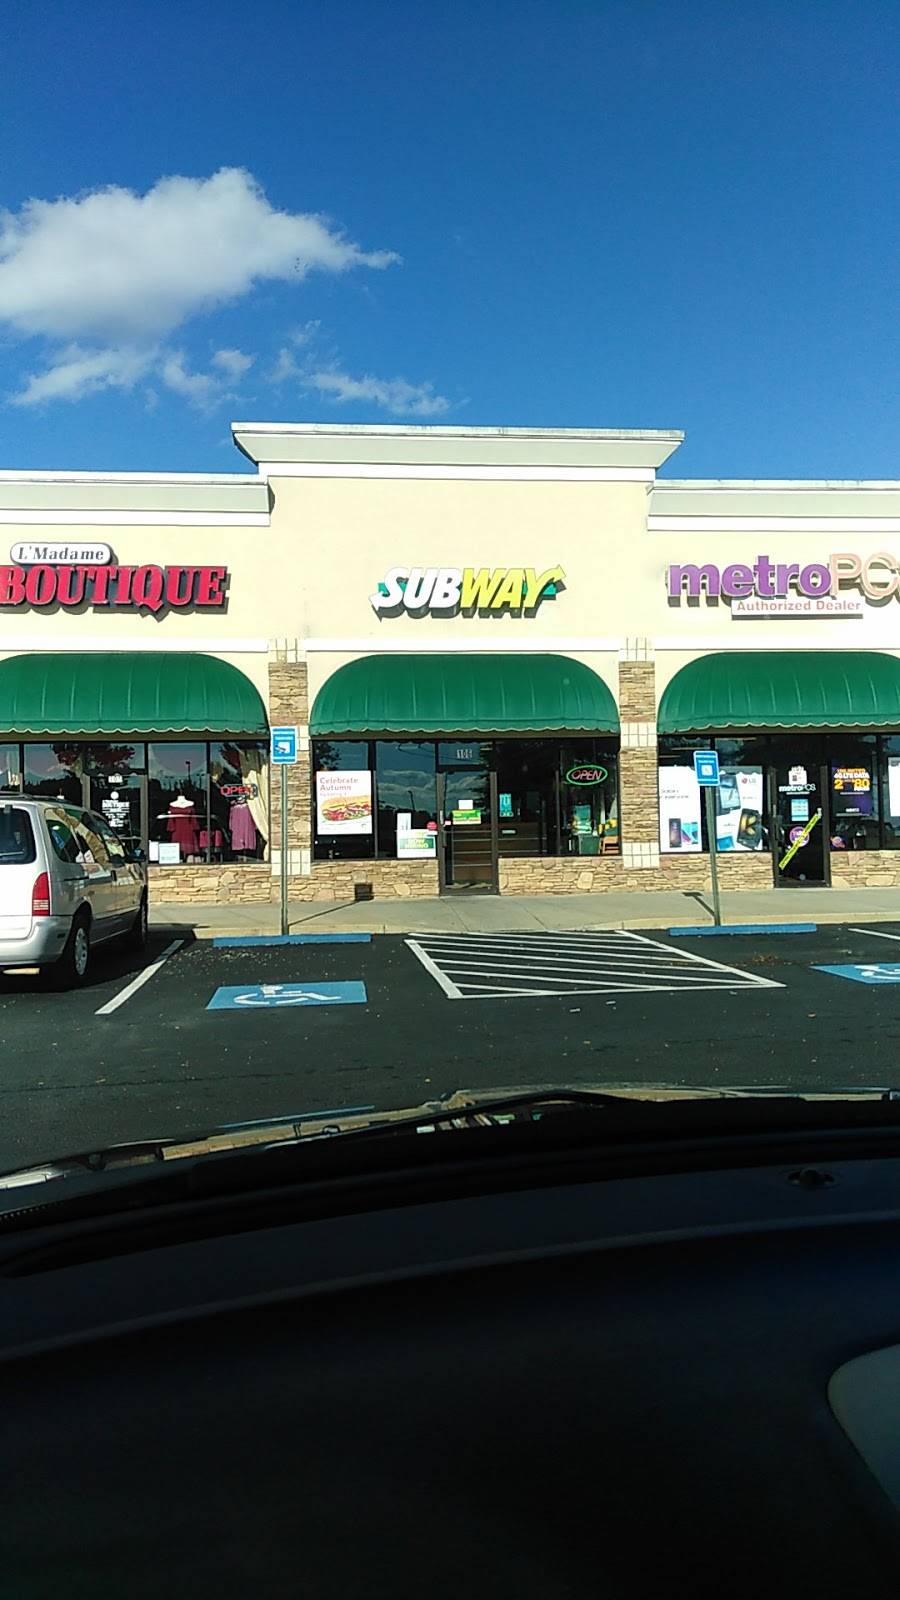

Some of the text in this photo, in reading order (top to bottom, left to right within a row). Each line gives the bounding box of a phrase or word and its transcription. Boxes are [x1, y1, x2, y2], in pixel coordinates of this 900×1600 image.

[18, 545, 104, 560] L'Madame
[668, 552, 900, 599] metroPC
[0, 564, 227, 612] BOUTIQUE
[368, 564, 567, 613] SUBWAY
[736, 600, 861, 612] Authorized Dealer
[319, 777, 359, 785] Celebrate
[571, 769, 602, 781] OPEN
